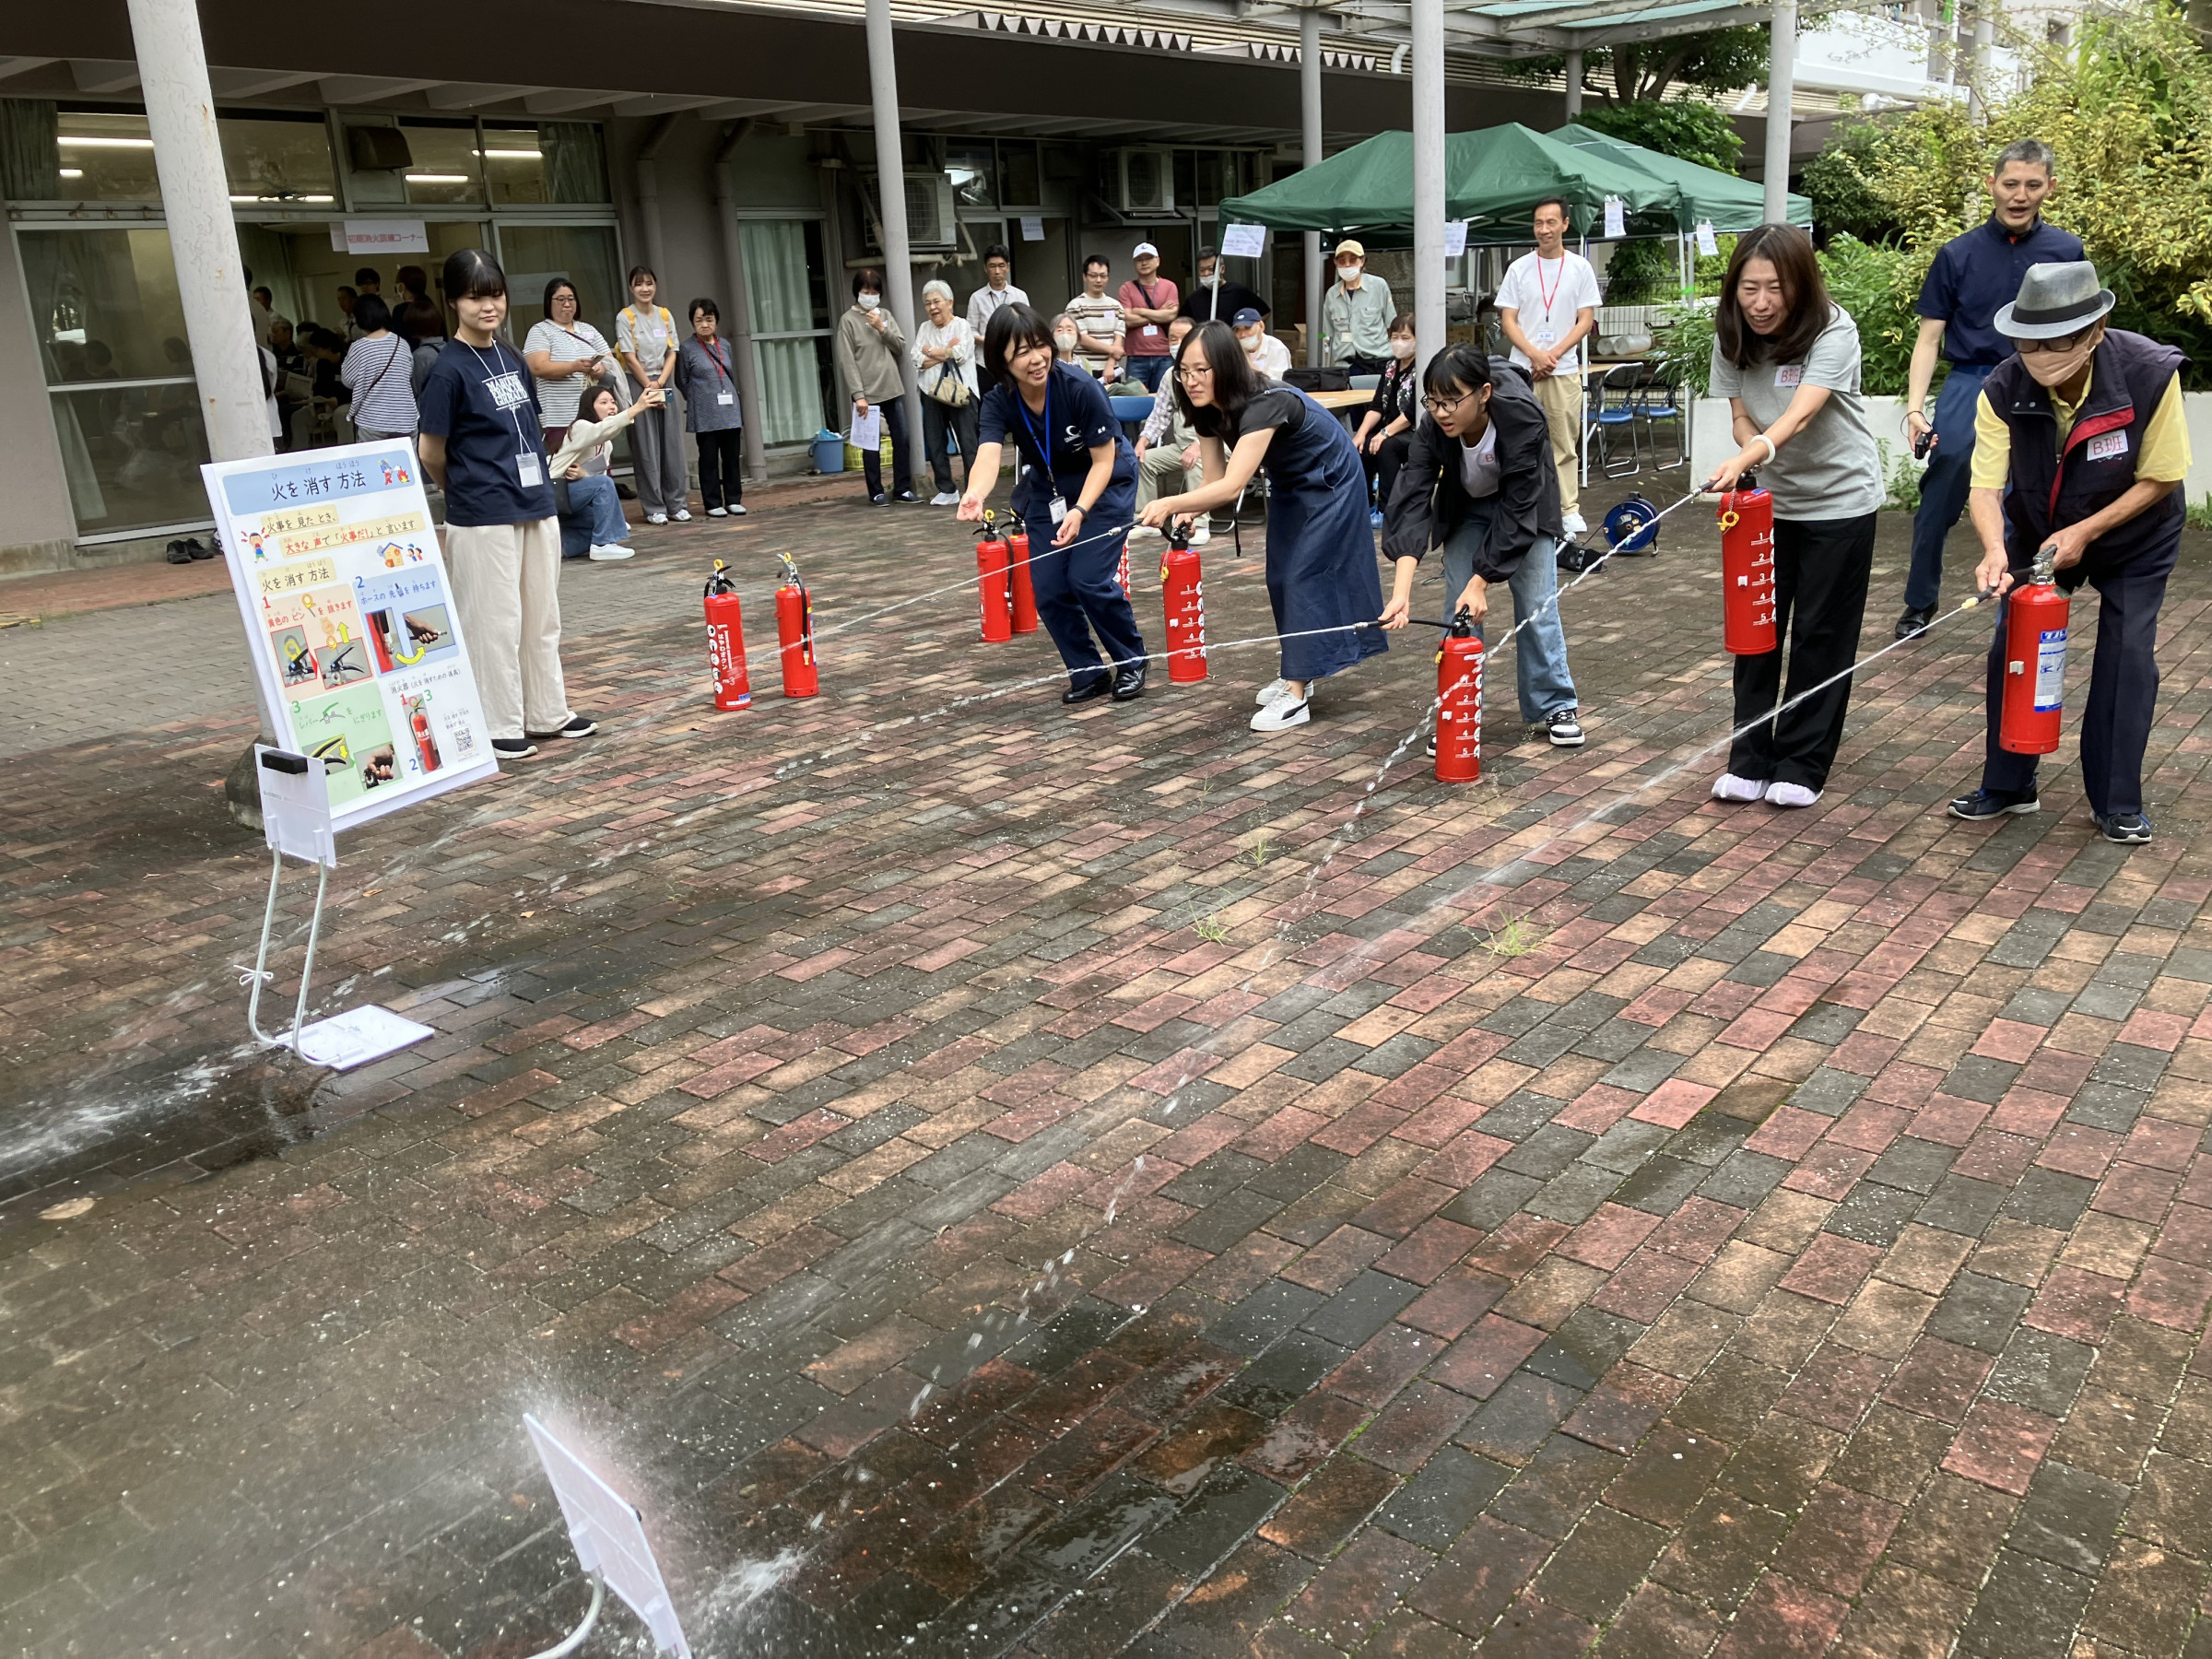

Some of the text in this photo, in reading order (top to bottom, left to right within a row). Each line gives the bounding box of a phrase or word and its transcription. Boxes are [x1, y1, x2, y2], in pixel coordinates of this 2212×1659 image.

[2093, 435, 2124, 455] B班
[271, 470, 367, 501] 火を 消す 方法
[266, 520, 293, 533] 火事を
[297, 516, 314, 529] 見た
[286, 540, 310, 555] 大きな
[313, 536, 330, 549] 声で
[377, 527, 382, 535] と
[387, 520, 416, 534] 言います
[1759, 553, 1764, 561] 2
[263, 567, 330, 592] 火を 消す 方法
[356, 576, 365, 588] 2
[1759, 573, 1765, 582] 3
[263, 596, 271, 608] 1
[361, 593, 385, 605] ホースの
[400, 693, 408, 706] 1
[424, 689, 432, 701] 3
[292, 700, 300, 713] 3
[409, 758, 418, 771] 2
